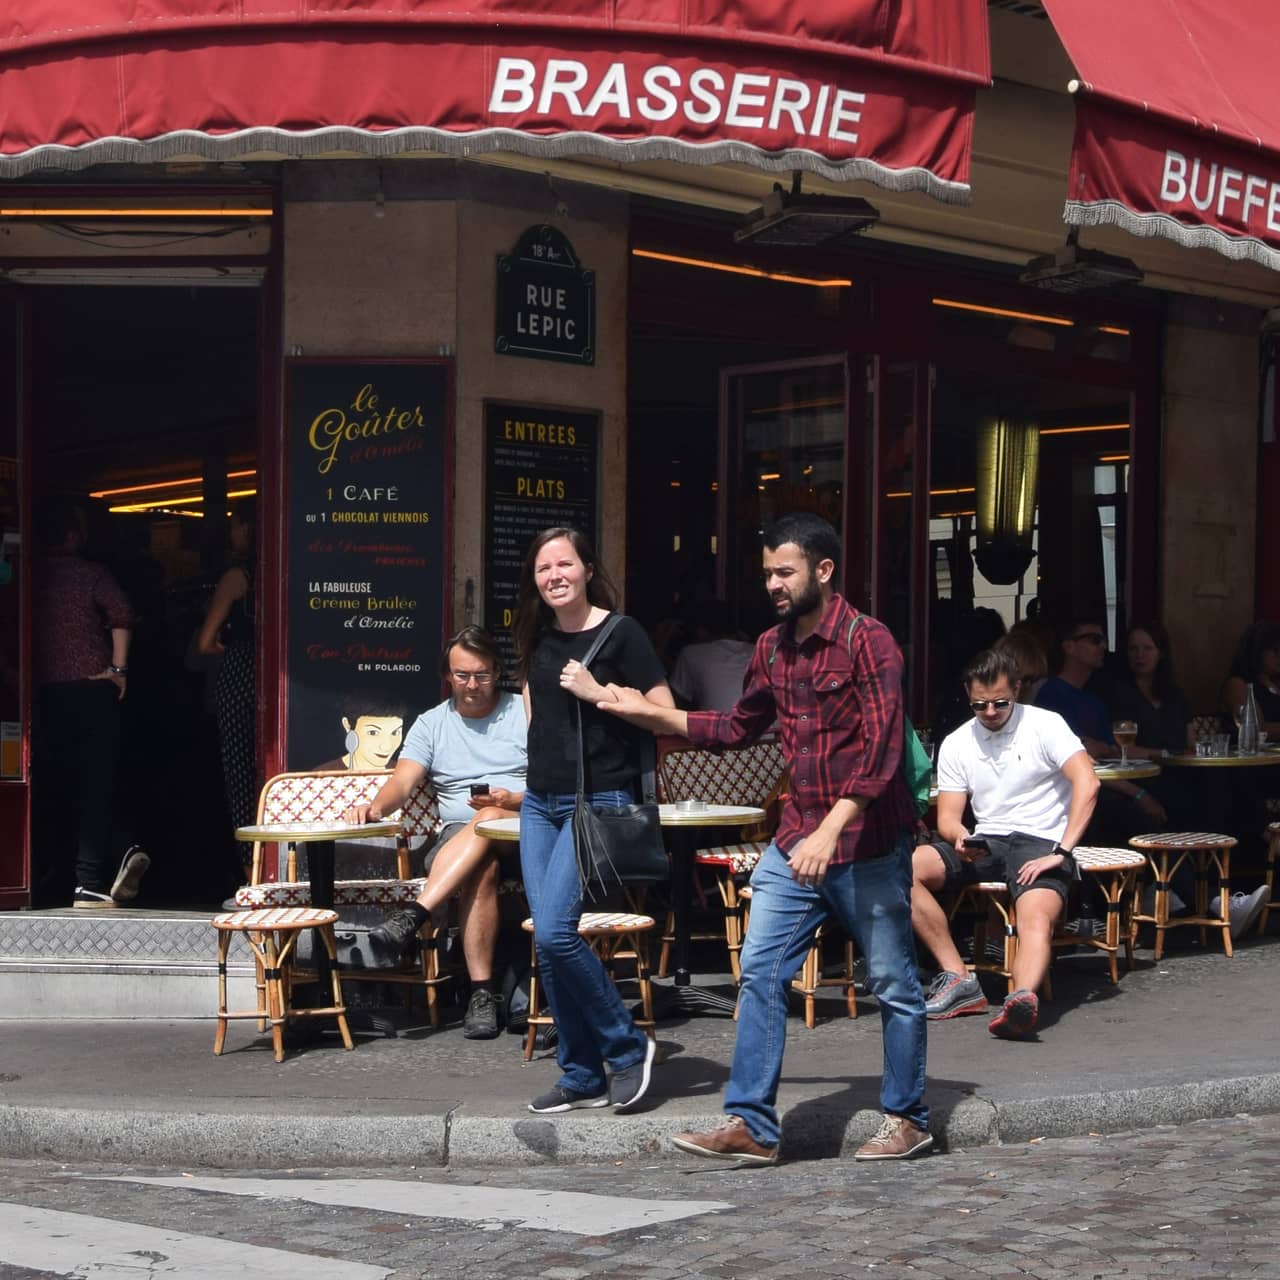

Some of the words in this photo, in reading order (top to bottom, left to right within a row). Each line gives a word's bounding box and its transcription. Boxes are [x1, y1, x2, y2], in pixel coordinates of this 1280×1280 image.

[488, 57, 866, 144] BRASSERIE
[527, 284, 566, 310] RUE
[517, 311, 575, 340] LEPIC
[350, 384, 379, 412] le
[308, 406, 426, 474] Goûter
[327, 488, 334, 500] 1
[517, 477, 565, 499] PLATS
[321, 513, 326, 523] 1
[332, 512, 379, 523] CHOCOLAT
[383, 512, 430, 524] VIENNOIS
[309, 582, 320, 593] LA
[323, 582, 372, 593] FABULEUSE
[344, 615, 415, 629] d'Amélie
[358, 663, 372, 671] EN
[375, 663, 421, 672] POLAROID
